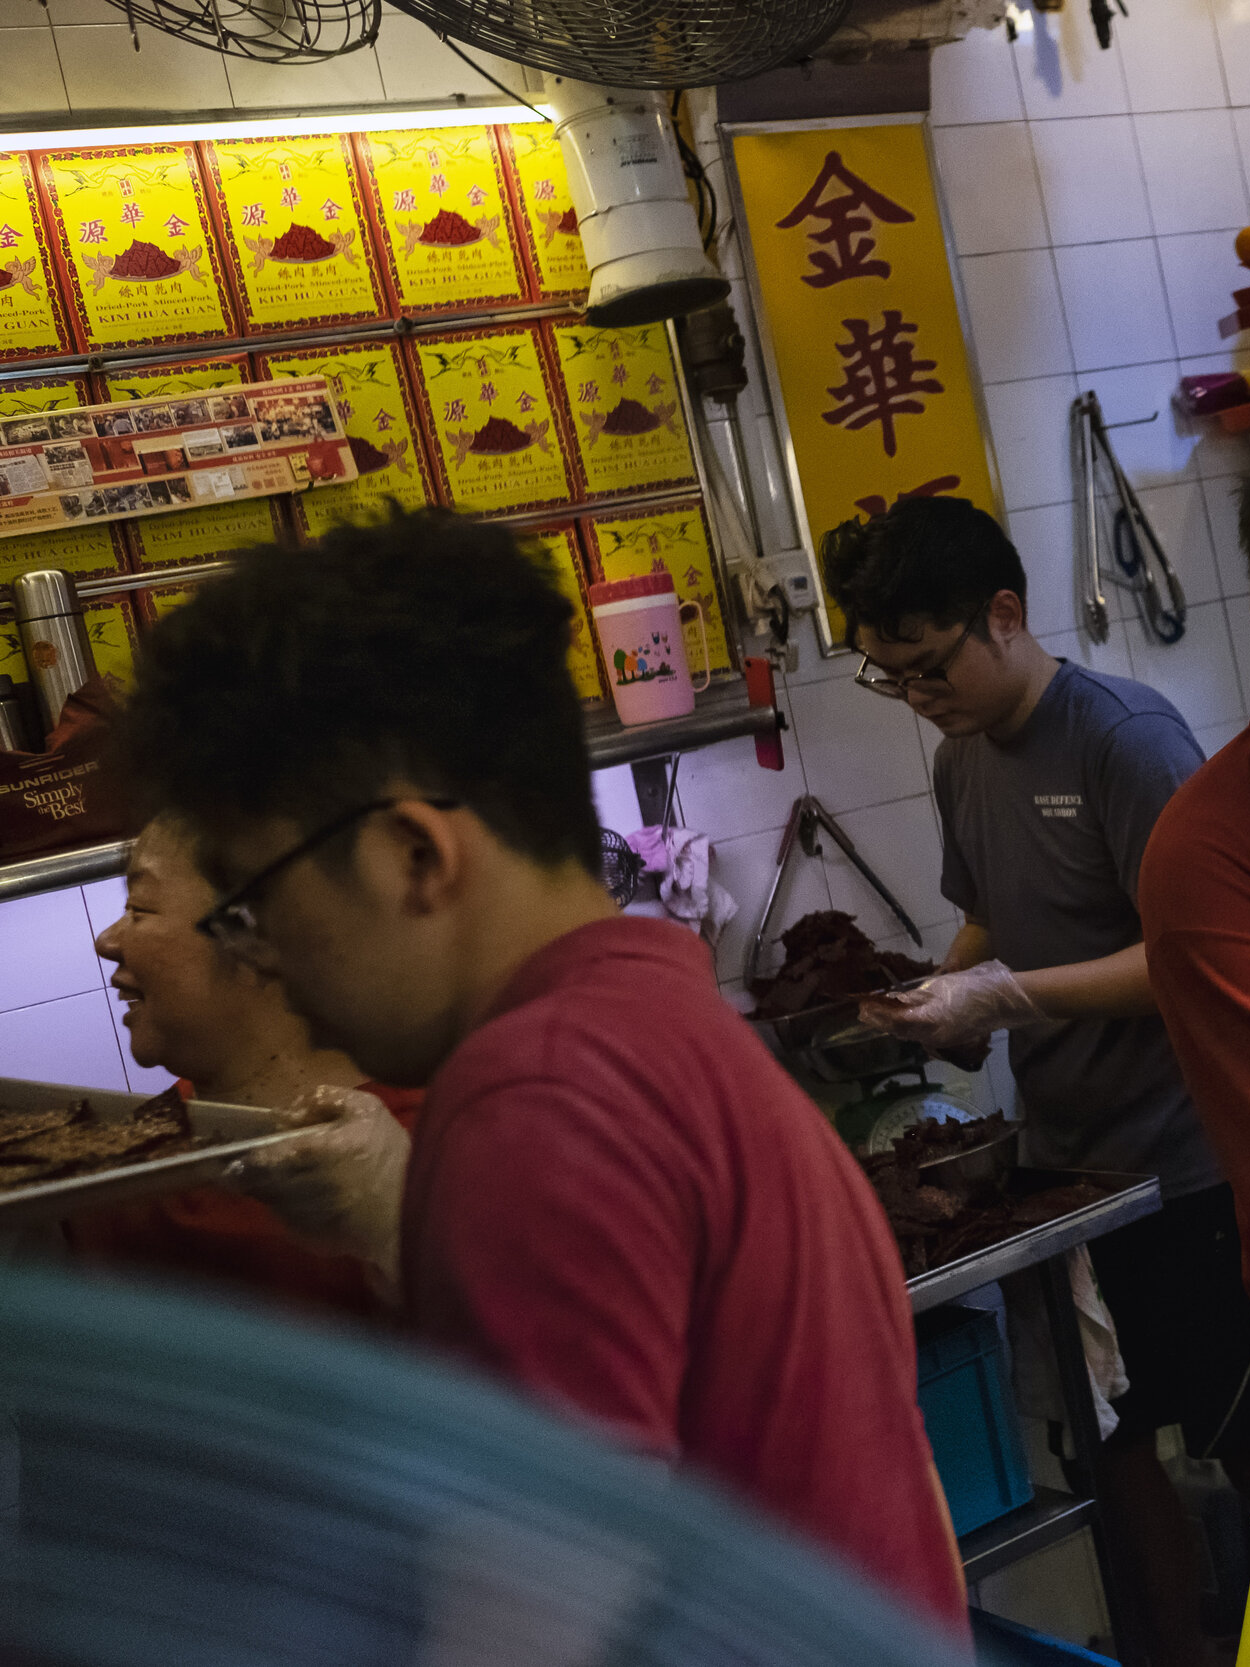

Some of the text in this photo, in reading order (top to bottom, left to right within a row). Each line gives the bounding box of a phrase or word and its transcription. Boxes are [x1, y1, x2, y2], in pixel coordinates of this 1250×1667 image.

[408, 269, 512, 287] KIM HUA GUAN
[258, 285, 369, 305] KIM HUA GUAN
[4, 318, 50, 330] GUAN
[98, 304, 217, 325] KIM HUA GUAN
[774, 150, 961, 513] 金華
[23, 781, 84, 809] Simply
[50, 798, 87, 821] Best
